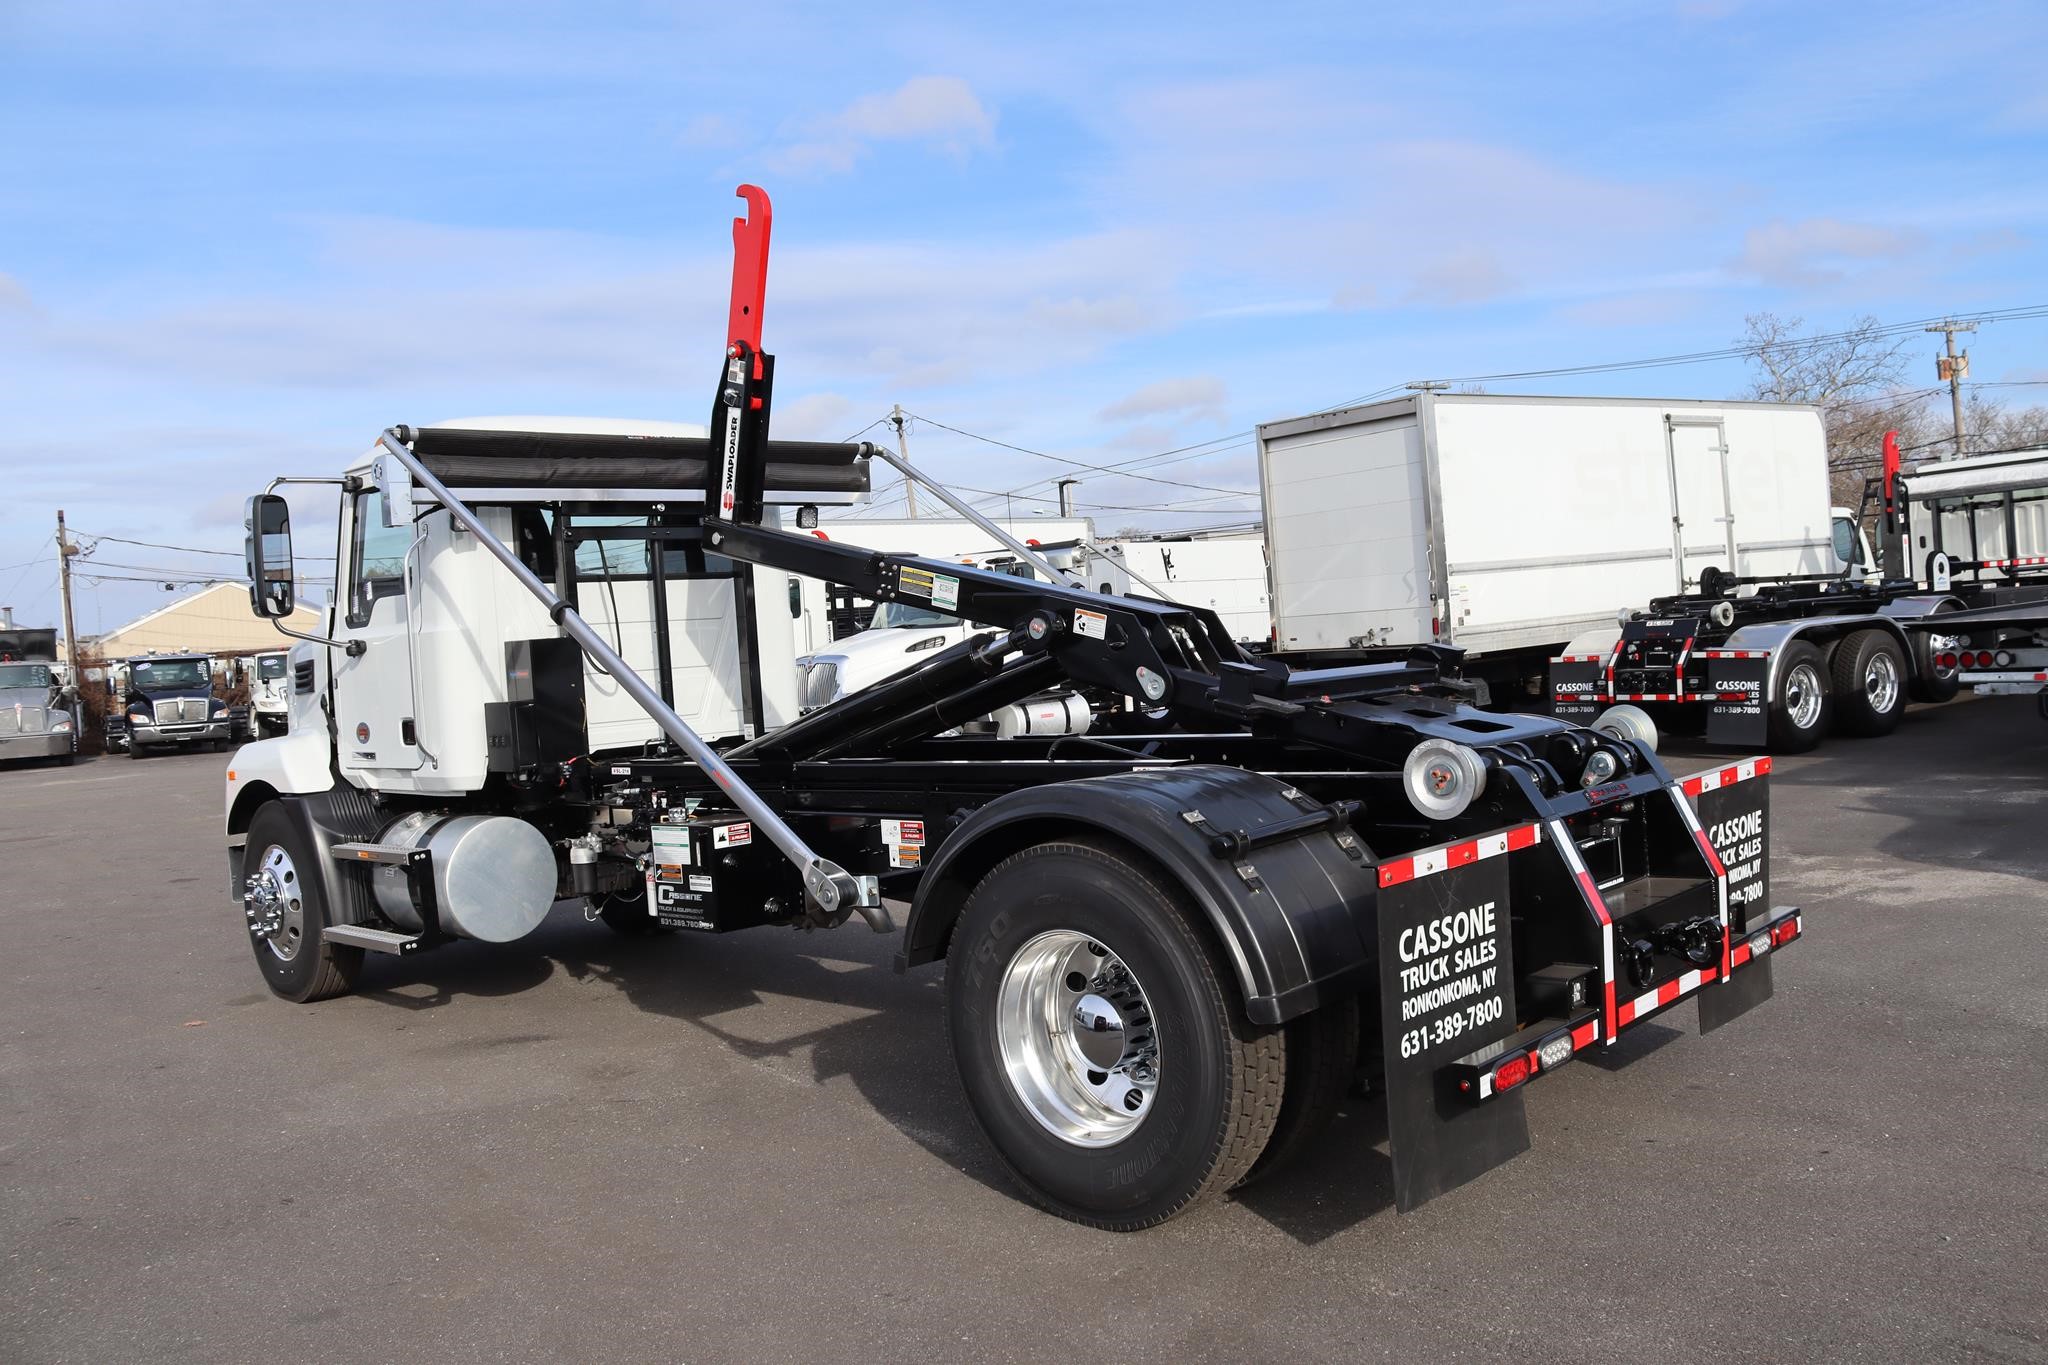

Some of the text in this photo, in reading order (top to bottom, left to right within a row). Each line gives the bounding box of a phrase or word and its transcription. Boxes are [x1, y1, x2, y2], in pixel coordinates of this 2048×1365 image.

[726, 416, 738, 490] SWAPLOADER
[1556, 682, 1593, 692] CASSONE
[1715, 681, 1760, 690] CASSONE
[1709, 810, 1762, 849] CASSONE
[1738, 838, 1762, 861] SALES
[1752, 858, 1762, 875] NY
[1399, 901, 1496, 963] CASSONE
[1400, 938, 1497, 993] TRUCK SALES
[1402, 966, 1497, 1021] RONKONKOMA, NY
[1400, 996, 1503, 1059] 631-389-7800
